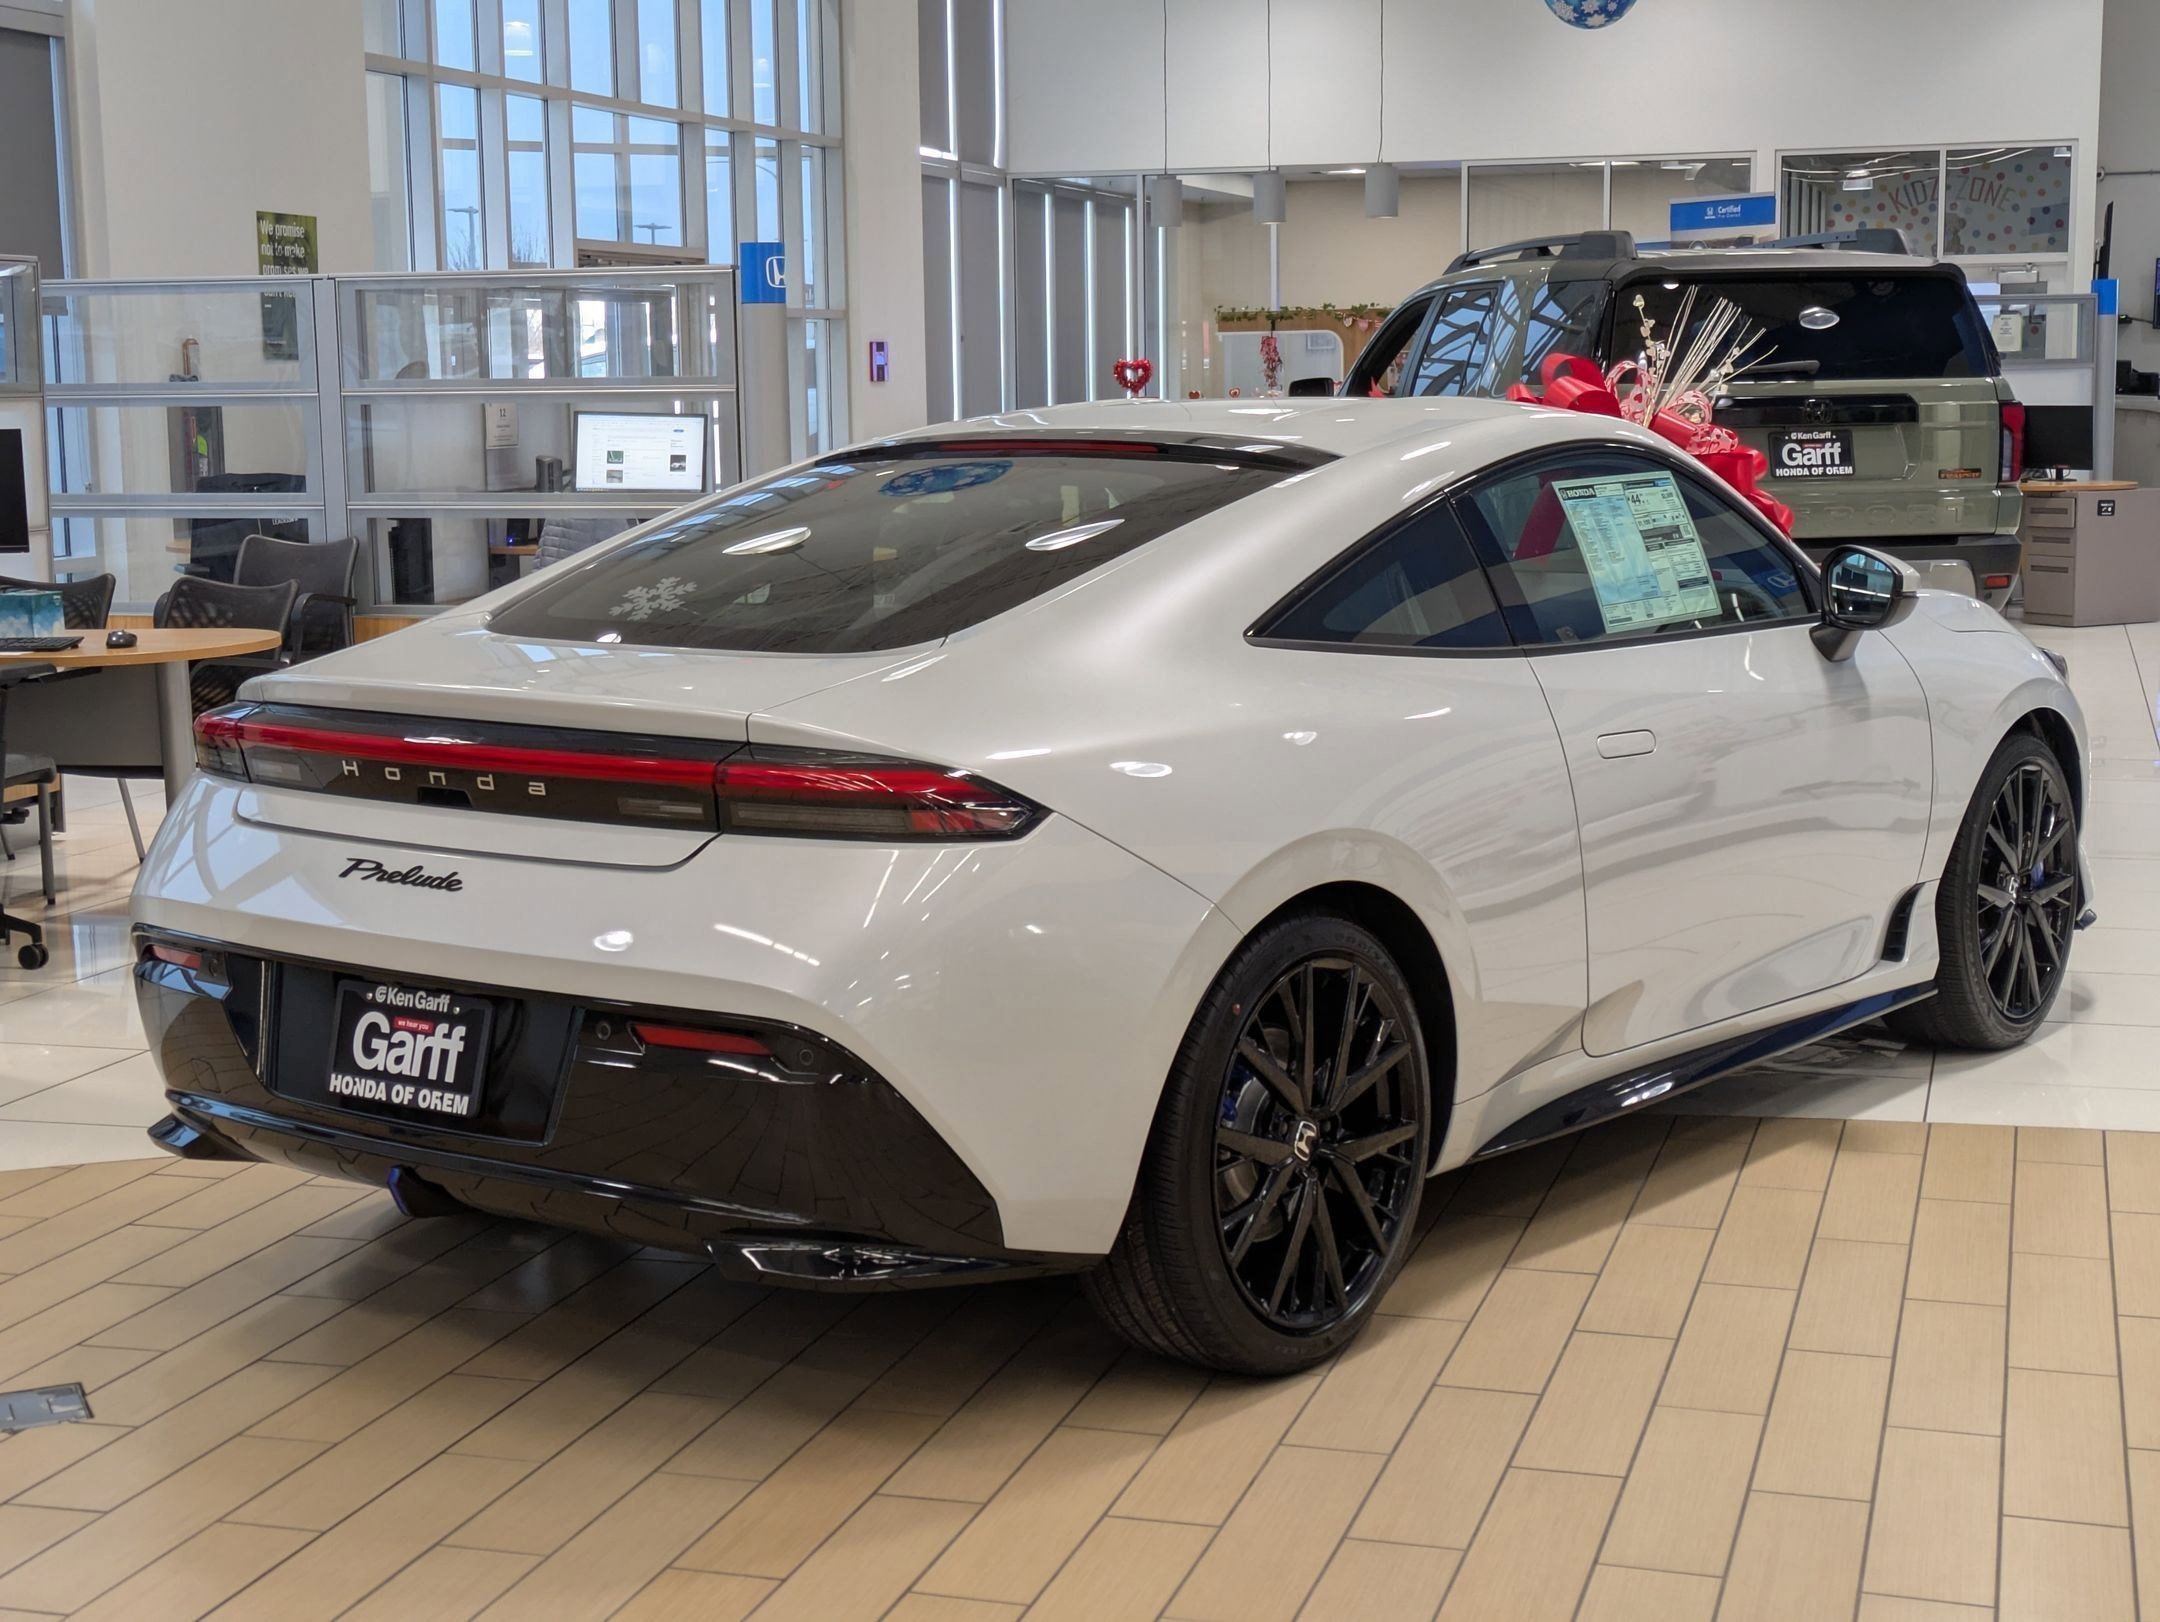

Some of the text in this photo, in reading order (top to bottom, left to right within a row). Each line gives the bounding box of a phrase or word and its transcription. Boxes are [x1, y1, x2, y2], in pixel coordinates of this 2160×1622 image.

[1888, 175, 2017, 214] KIDZ ZONE
[260, 219, 305, 239] We promise
[261, 242, 274, 256] not
[284, 243, 305, 258] make
[1798, 431, 1831, 440] Ken Garff
[1781, 441, 1841, 466] Garff
[1775, 465, 1853, 477] HONDA OF OREM
[1566, 487, 1595, 498] HONDA
[338, 857, 464, 892] Prelude
[386, 986, 451, 1013] Ken Garff
[353, 1011, 466, 1084] Garff
[329, 1073, 470, 1116] HONDA OF OREM
